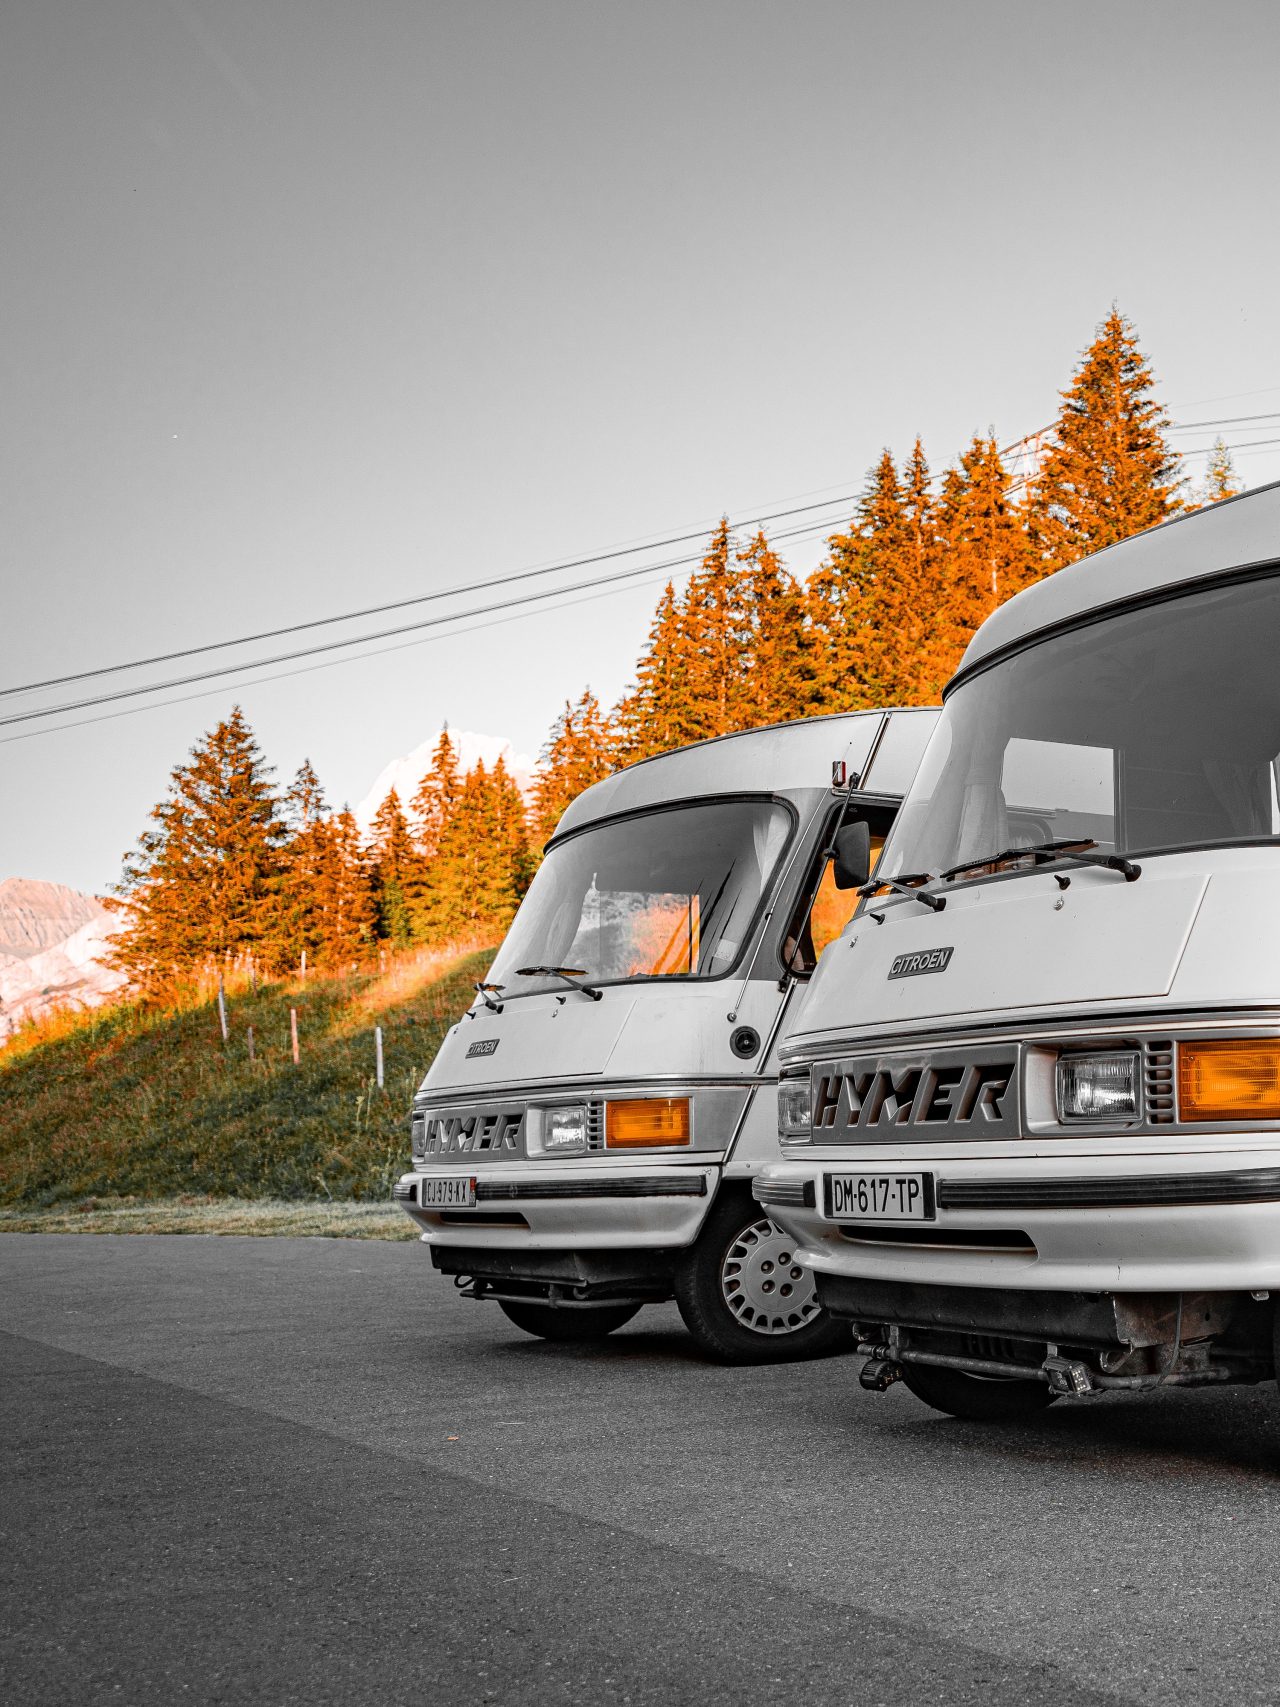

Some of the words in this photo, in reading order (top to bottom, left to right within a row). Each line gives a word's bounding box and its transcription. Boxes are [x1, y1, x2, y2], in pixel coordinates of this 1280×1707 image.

[891, 948, 949, 974] CITROËN
[813, 1063, 1016, 1129] HYMER
[425, 1114, 523, 1153] HYMER
[834, 1178, 920, 1213] DM-617-TP
